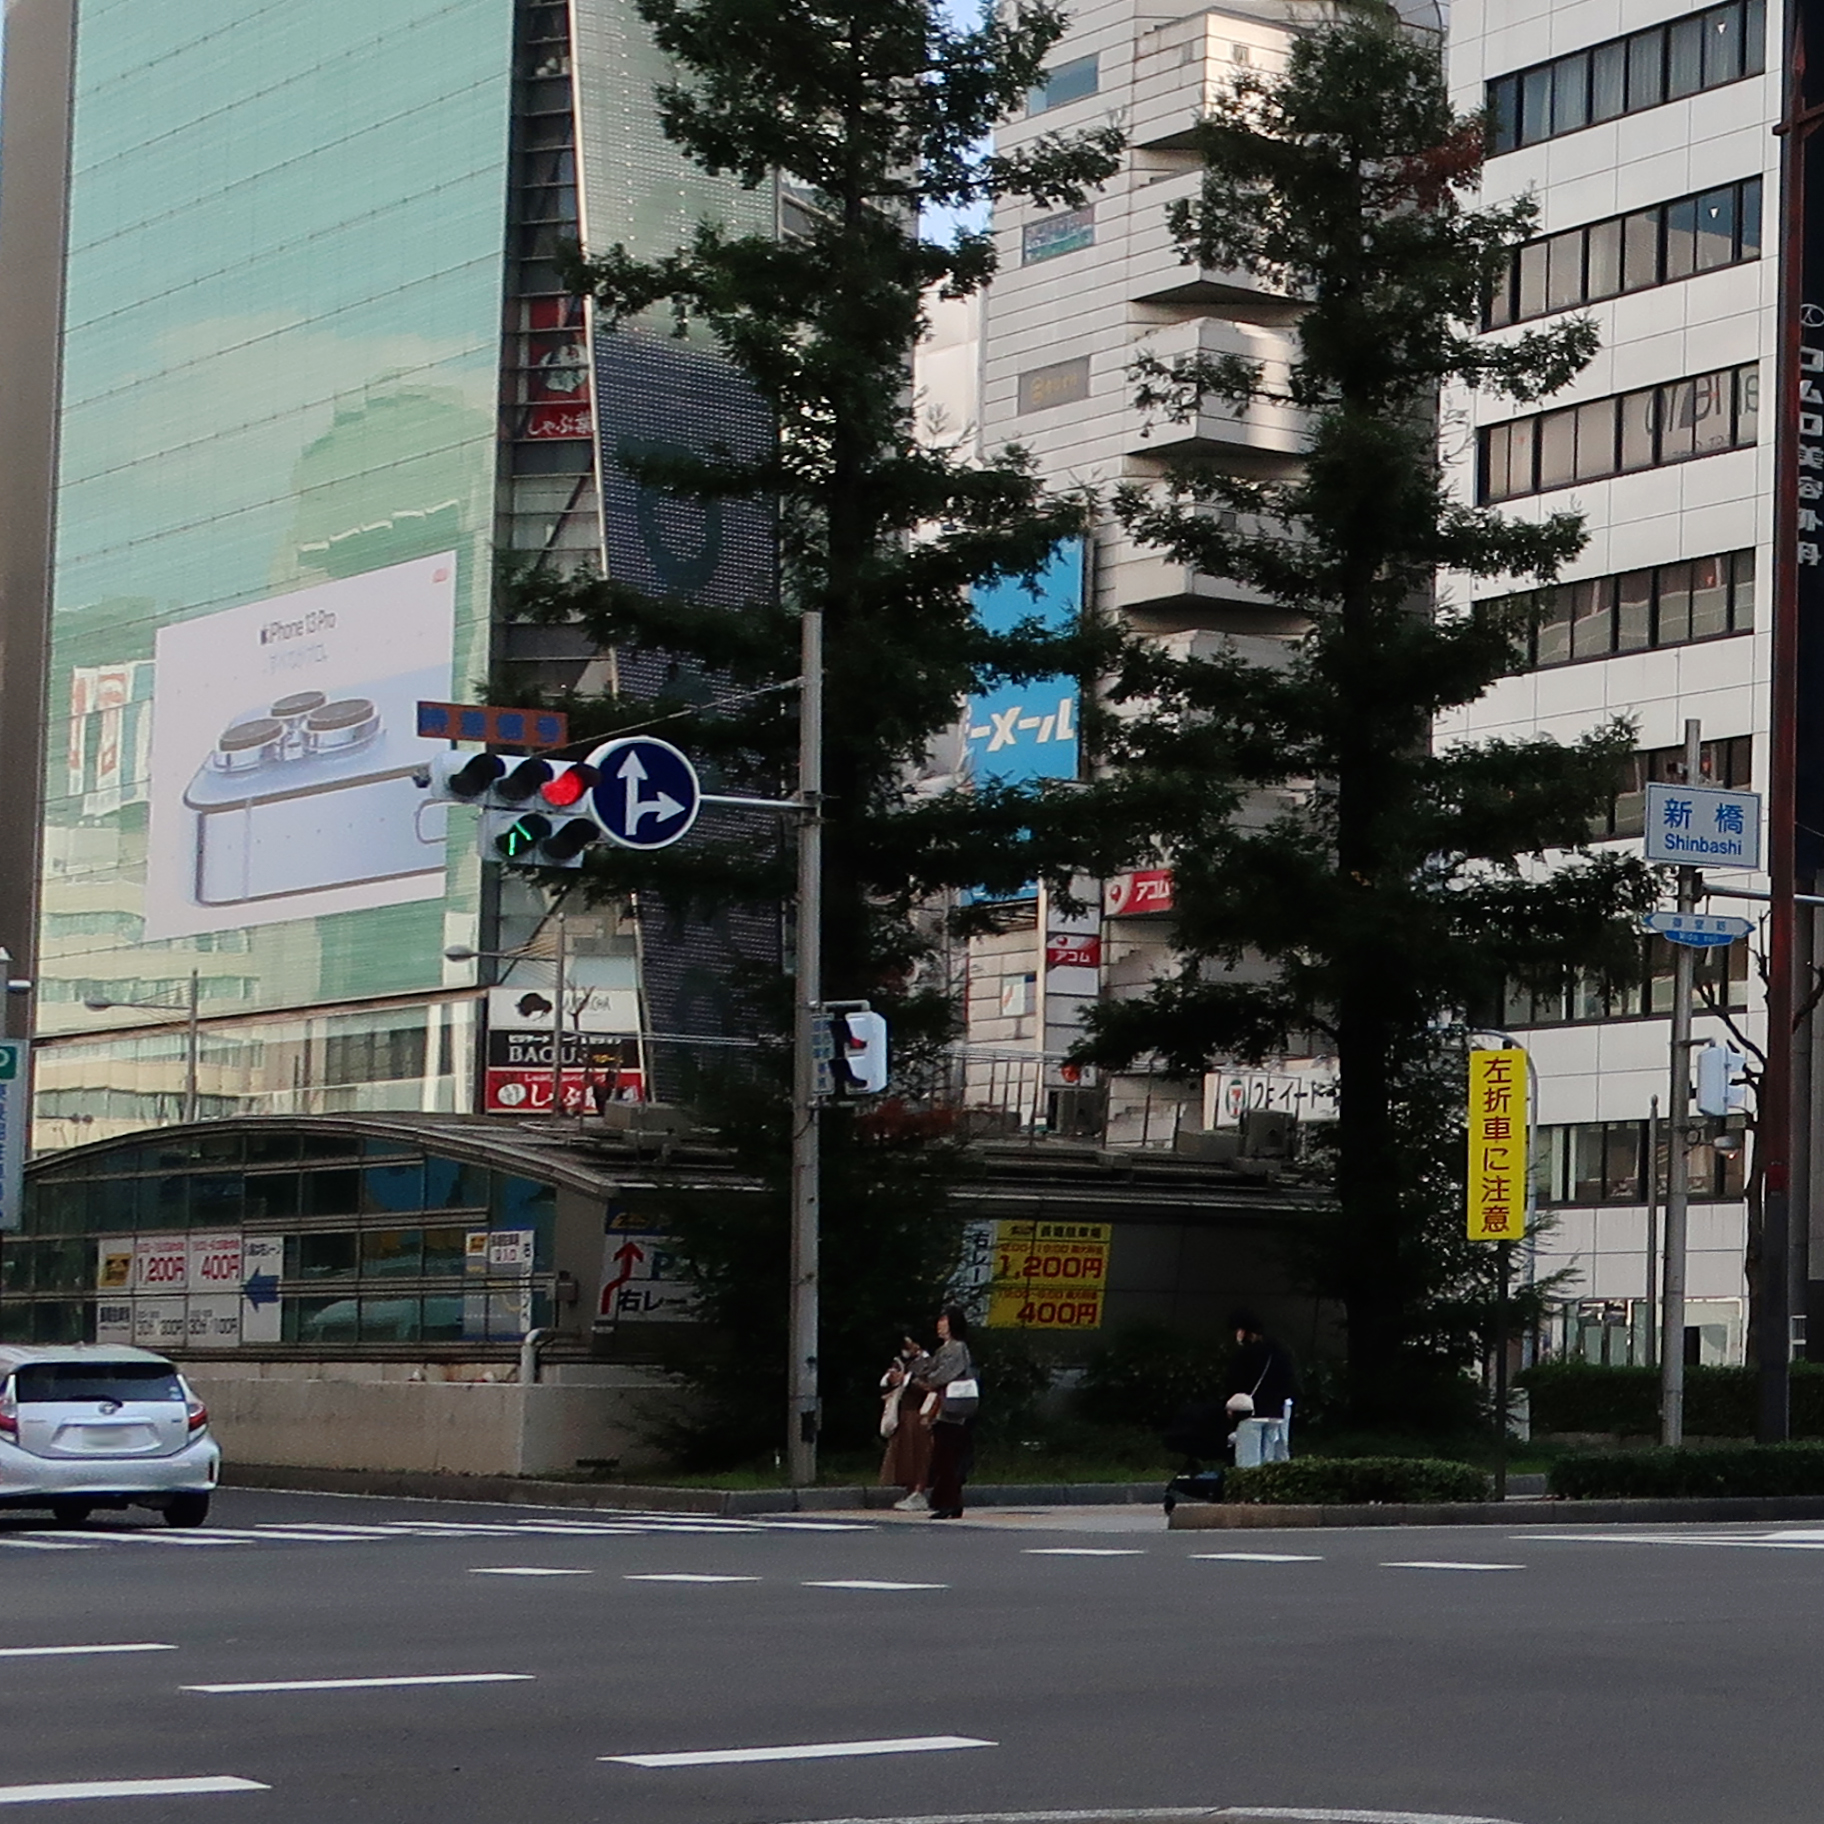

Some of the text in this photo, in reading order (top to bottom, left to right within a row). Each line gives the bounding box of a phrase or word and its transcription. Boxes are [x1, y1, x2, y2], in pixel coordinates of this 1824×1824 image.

[318, 609, 338, 630] Pro
[1663, 797, 1745, 835] 新橋
[1664, 832, 1743, 856] Shinbashi
[1135, 877, 1171, 903] アコム
[1055, 950, 1092, 963] アコム
[1481, 1056, 1513, 1233] 左折車に注意
[201, 1254, 240, 1280] 400円
[1000, 1254, 1103, 1279] 1,200円
[1017, 1301, 1098, 1325] 400円
